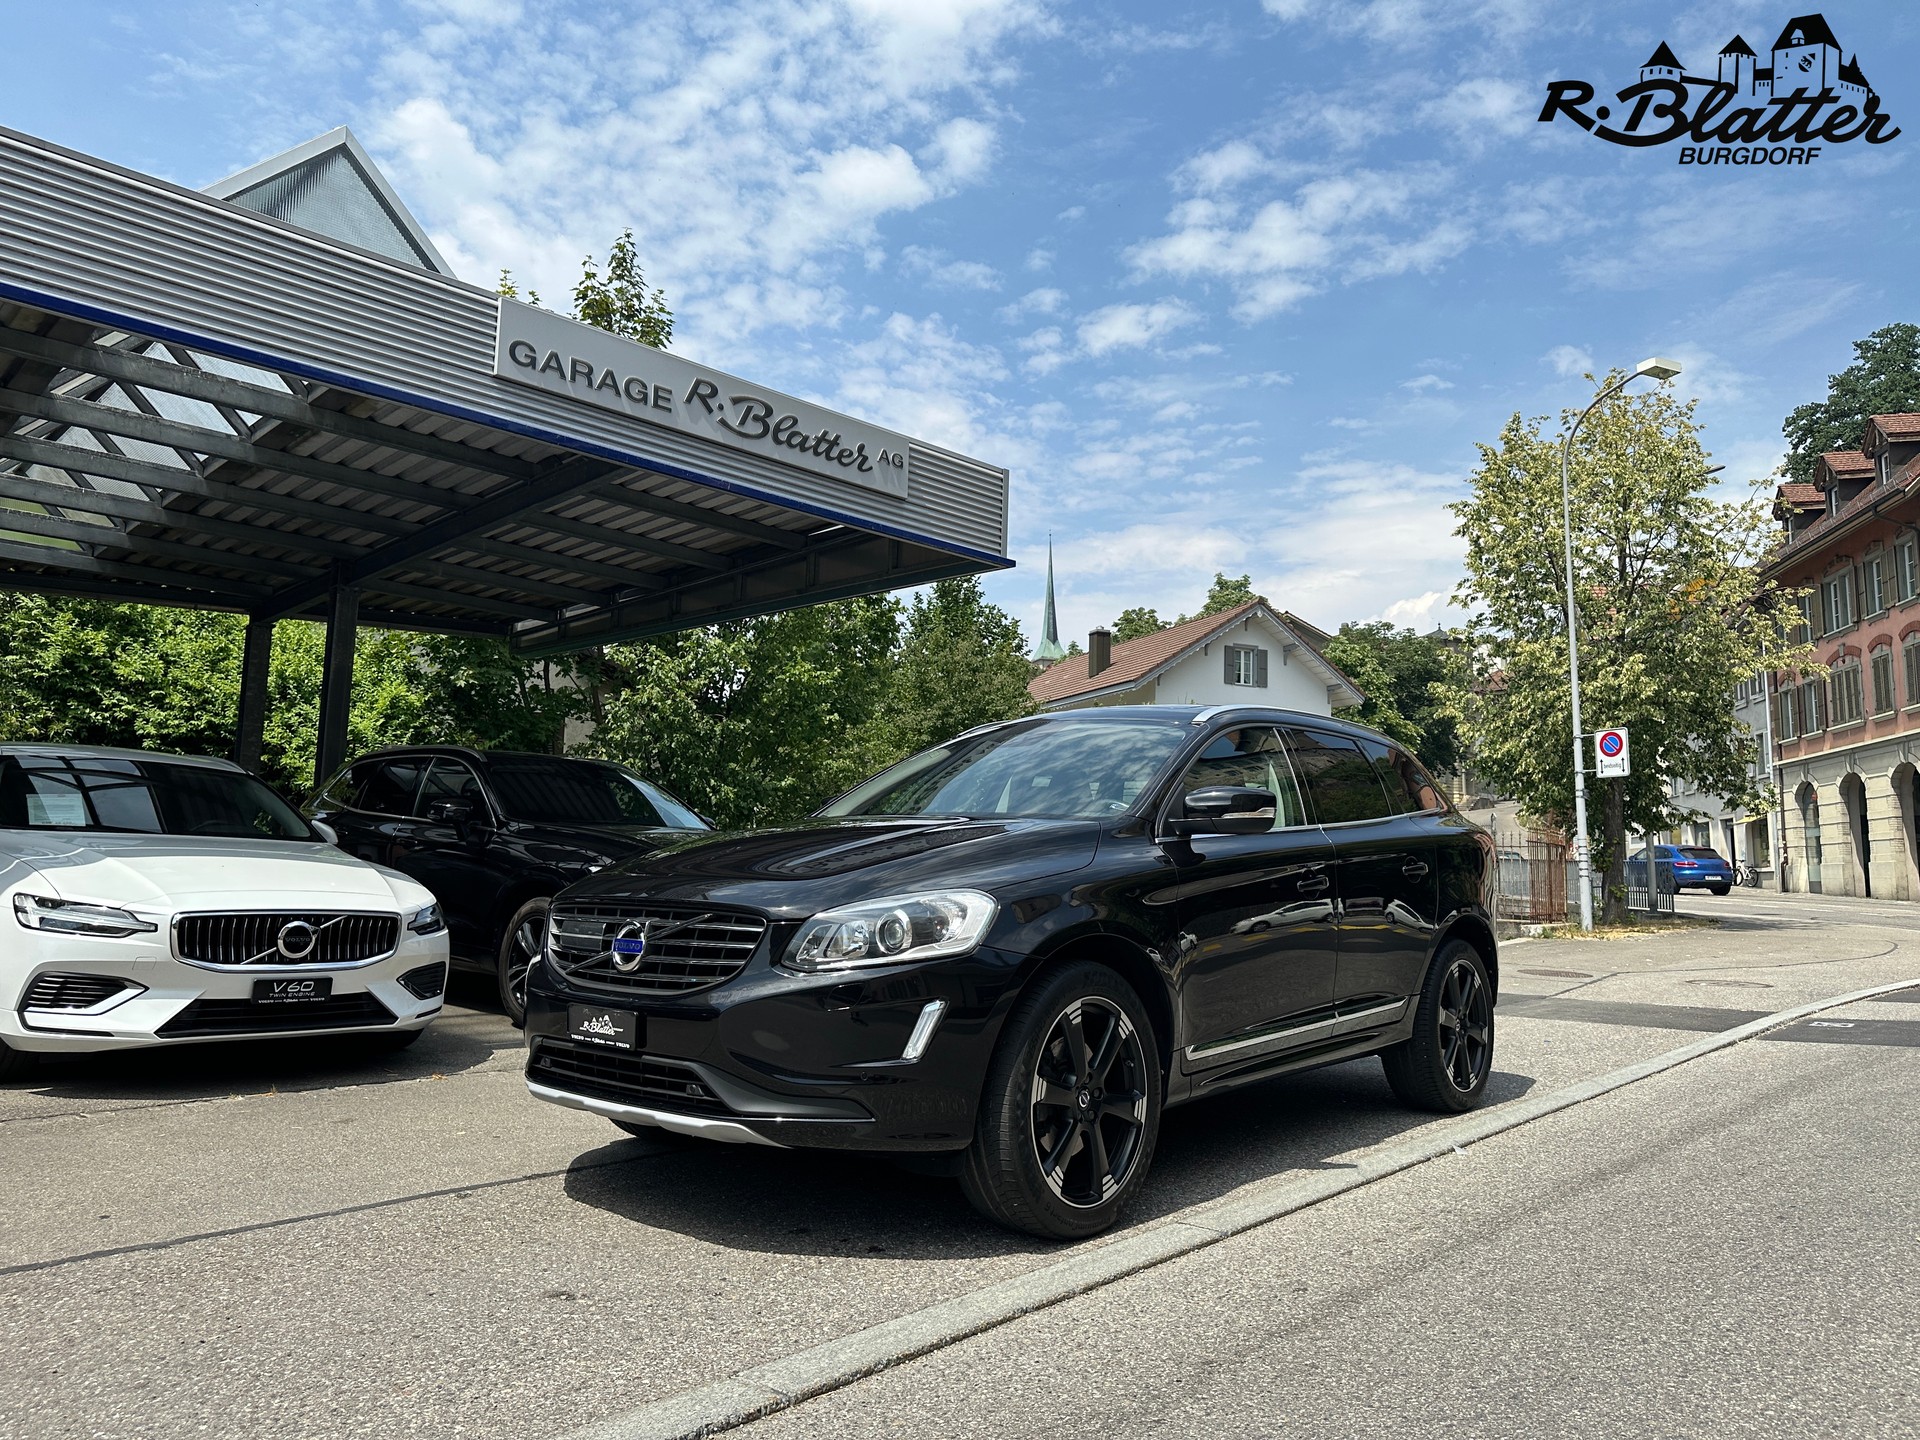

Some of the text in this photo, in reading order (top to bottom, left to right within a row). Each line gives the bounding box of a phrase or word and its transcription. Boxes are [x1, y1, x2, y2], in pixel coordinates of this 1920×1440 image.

[509, 339, 672, 413] GARAGE
[877, 448, 904, 470] AG
[615, 941, 641, 950] VOLVO
